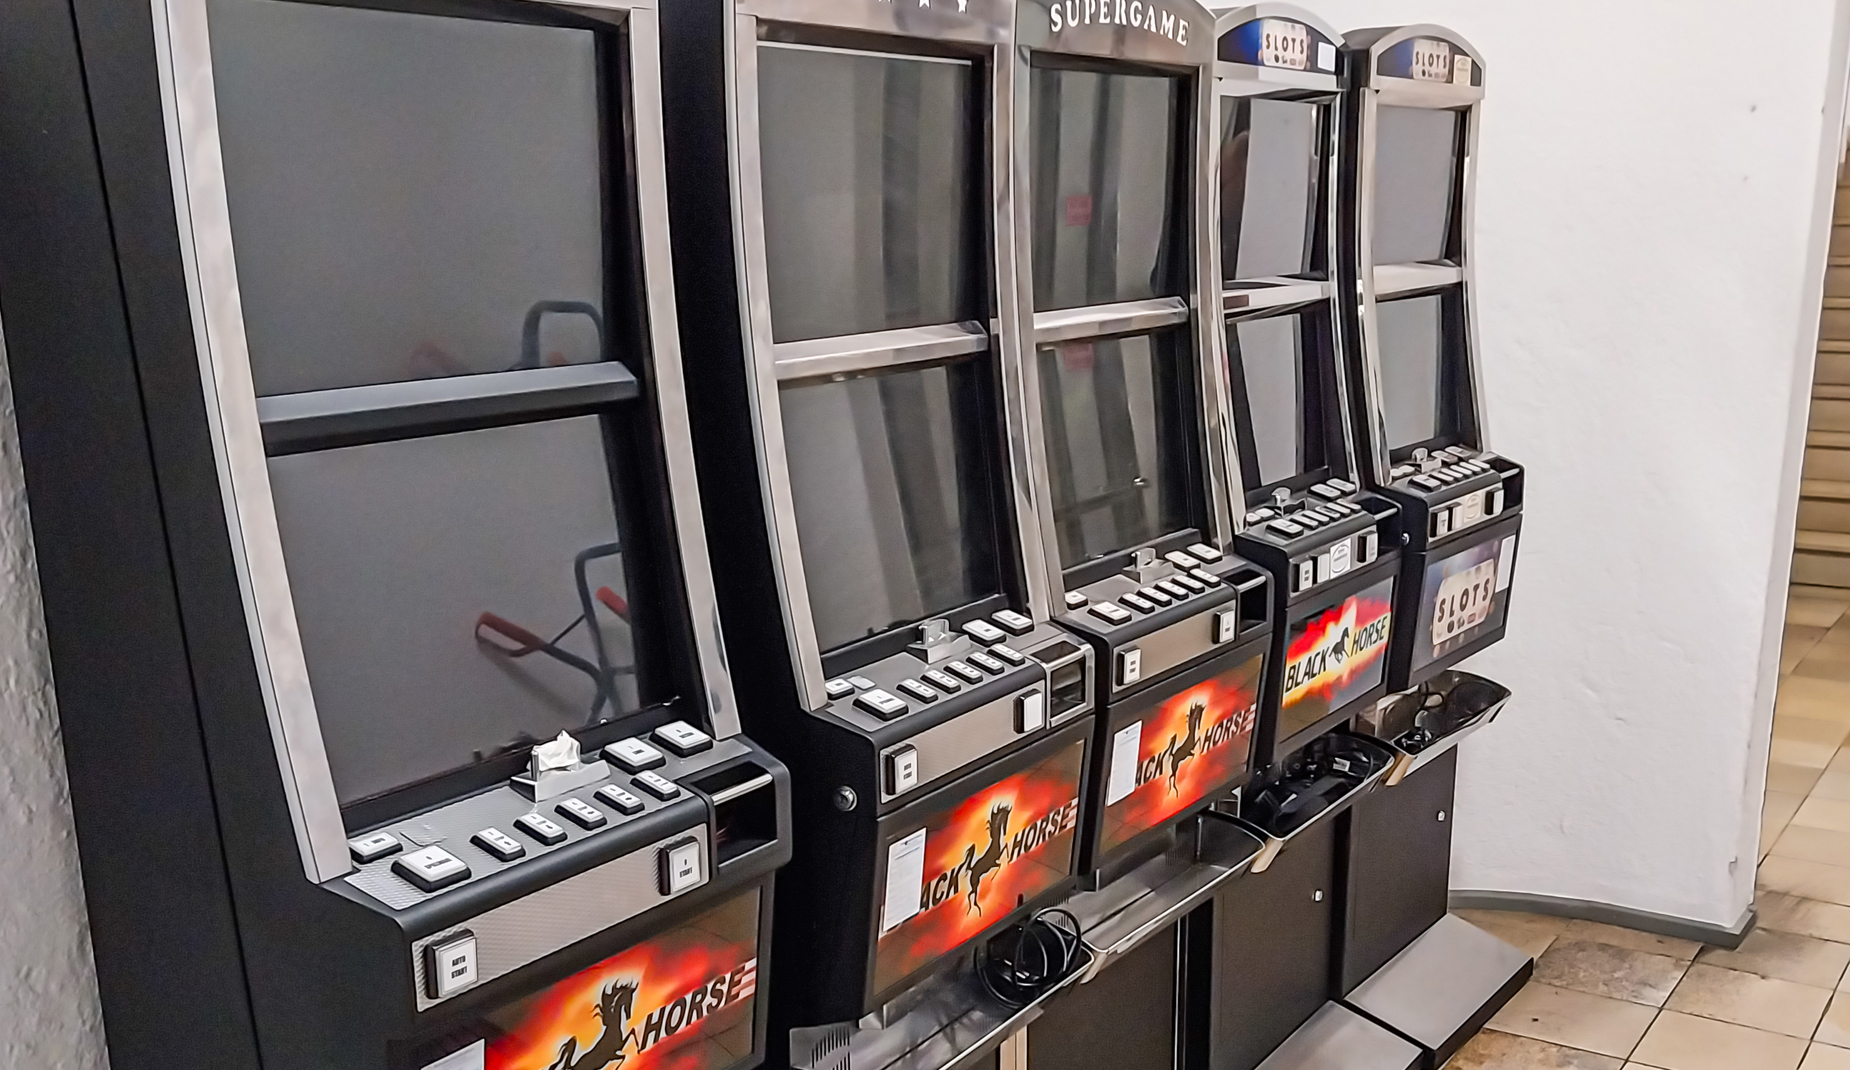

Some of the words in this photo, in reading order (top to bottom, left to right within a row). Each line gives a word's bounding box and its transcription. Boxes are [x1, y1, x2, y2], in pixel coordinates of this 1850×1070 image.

[1050, 0, 1189, 46] SUPERGAME
[1265, 33, 1305, 55] SLOTS
[1415, 51, 1448, 70] SLOTS
[1438, 578, 1491, 623] SLOTS
[1285, 648, 1330, 693] BLACK
[1351, 614, 1388, 656] HORSE
[1135, 751, 1166, 788] ACK
[1201, 710, 1252, 755] HORSE
[920, 864, 961, 912] ACK
[1008, 801, 1073, 865] HORSE
[451, 966, 468, 980] START
[452, 955, 466, 967] AUTO
[640, 965, 746, 1053] HORSE
